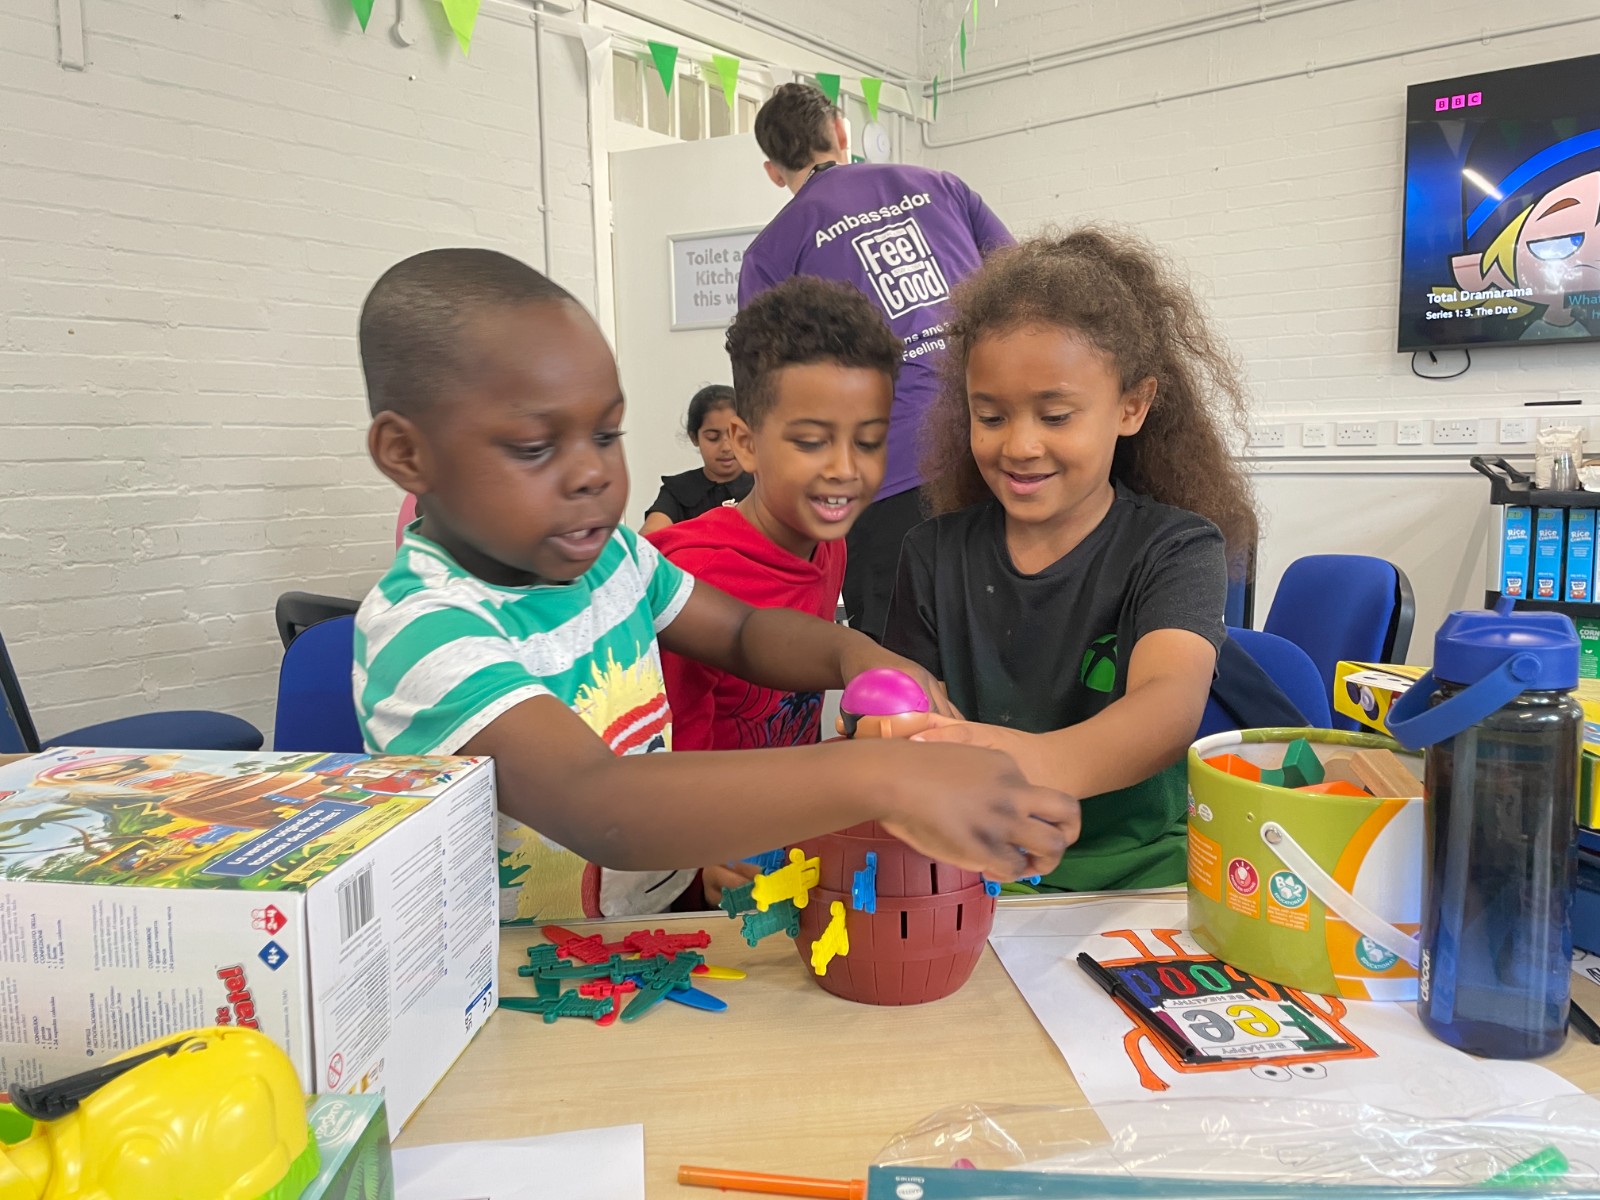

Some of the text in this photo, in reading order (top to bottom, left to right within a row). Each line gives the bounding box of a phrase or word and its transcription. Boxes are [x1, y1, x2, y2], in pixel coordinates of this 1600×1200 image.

[1437, 94, 1480, 110] BBC
[815, 193, 931, 248] Ambassador
[686, 248, 744, 266] Toilet a
[859, 224, 926, 275] Feel
[878, 260, 945, 310] Good
[693, 290, 721, 307] this
[1427, 287, 1533, 304] Total Dramarama
[1426, 305, 1518, 320] Series 1: 3. The Date
[903, 333, 919, 345] ns
[902, 338, 946, 362] Feeling
[243, 837, 280, 857] version
[217, 965, 259, 1030] rate!
[1221, 1041, 1287, 1055] BE HAPPY
